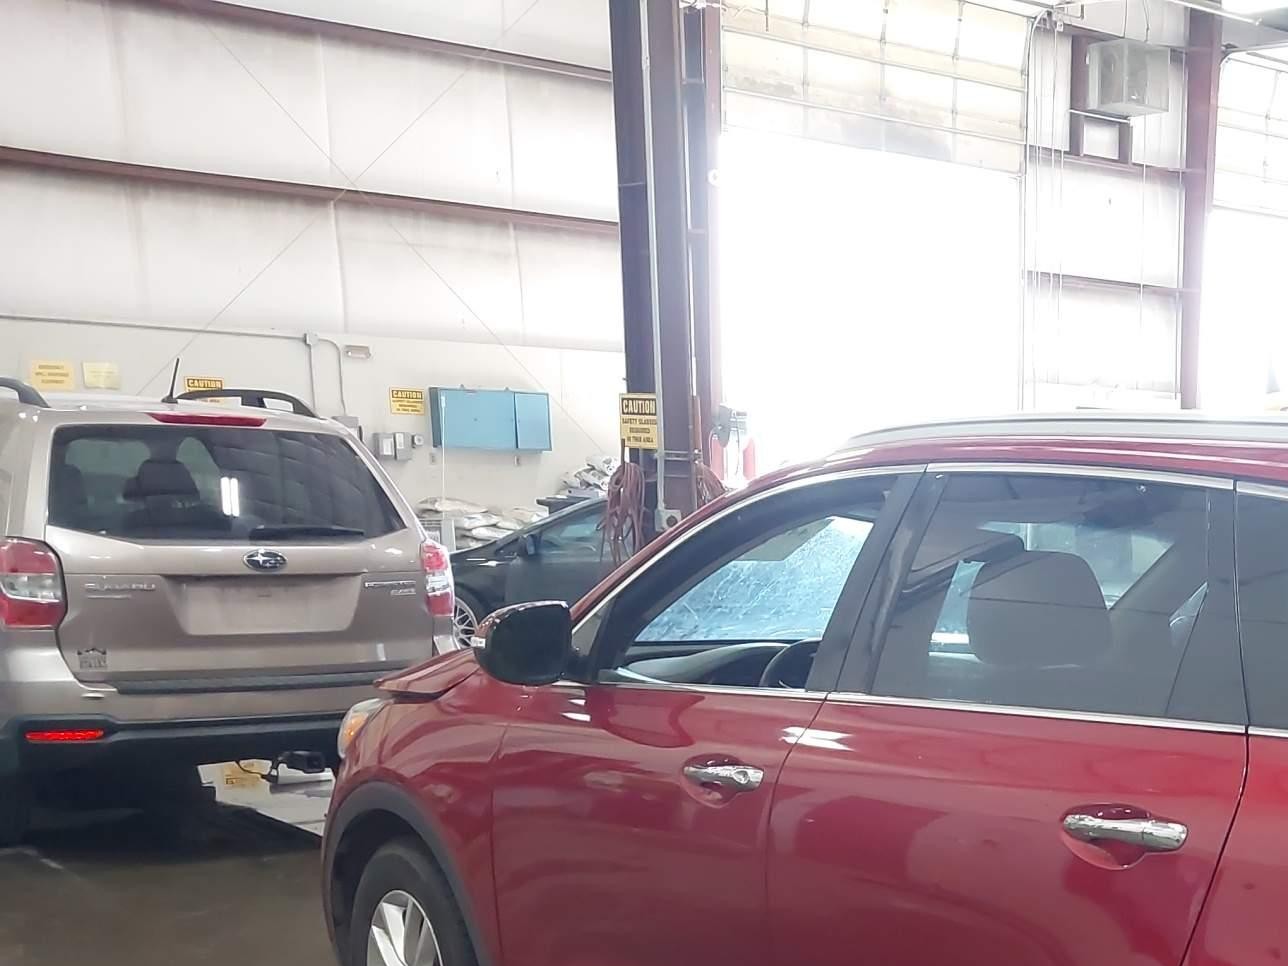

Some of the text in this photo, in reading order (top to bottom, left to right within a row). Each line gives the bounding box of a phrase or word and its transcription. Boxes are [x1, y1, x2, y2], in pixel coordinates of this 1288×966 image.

[188, 379, 222, 388] CAUTION
[392, 390, 422, 399] CAUTION
[623, 400, 655, 413] CAUTION
